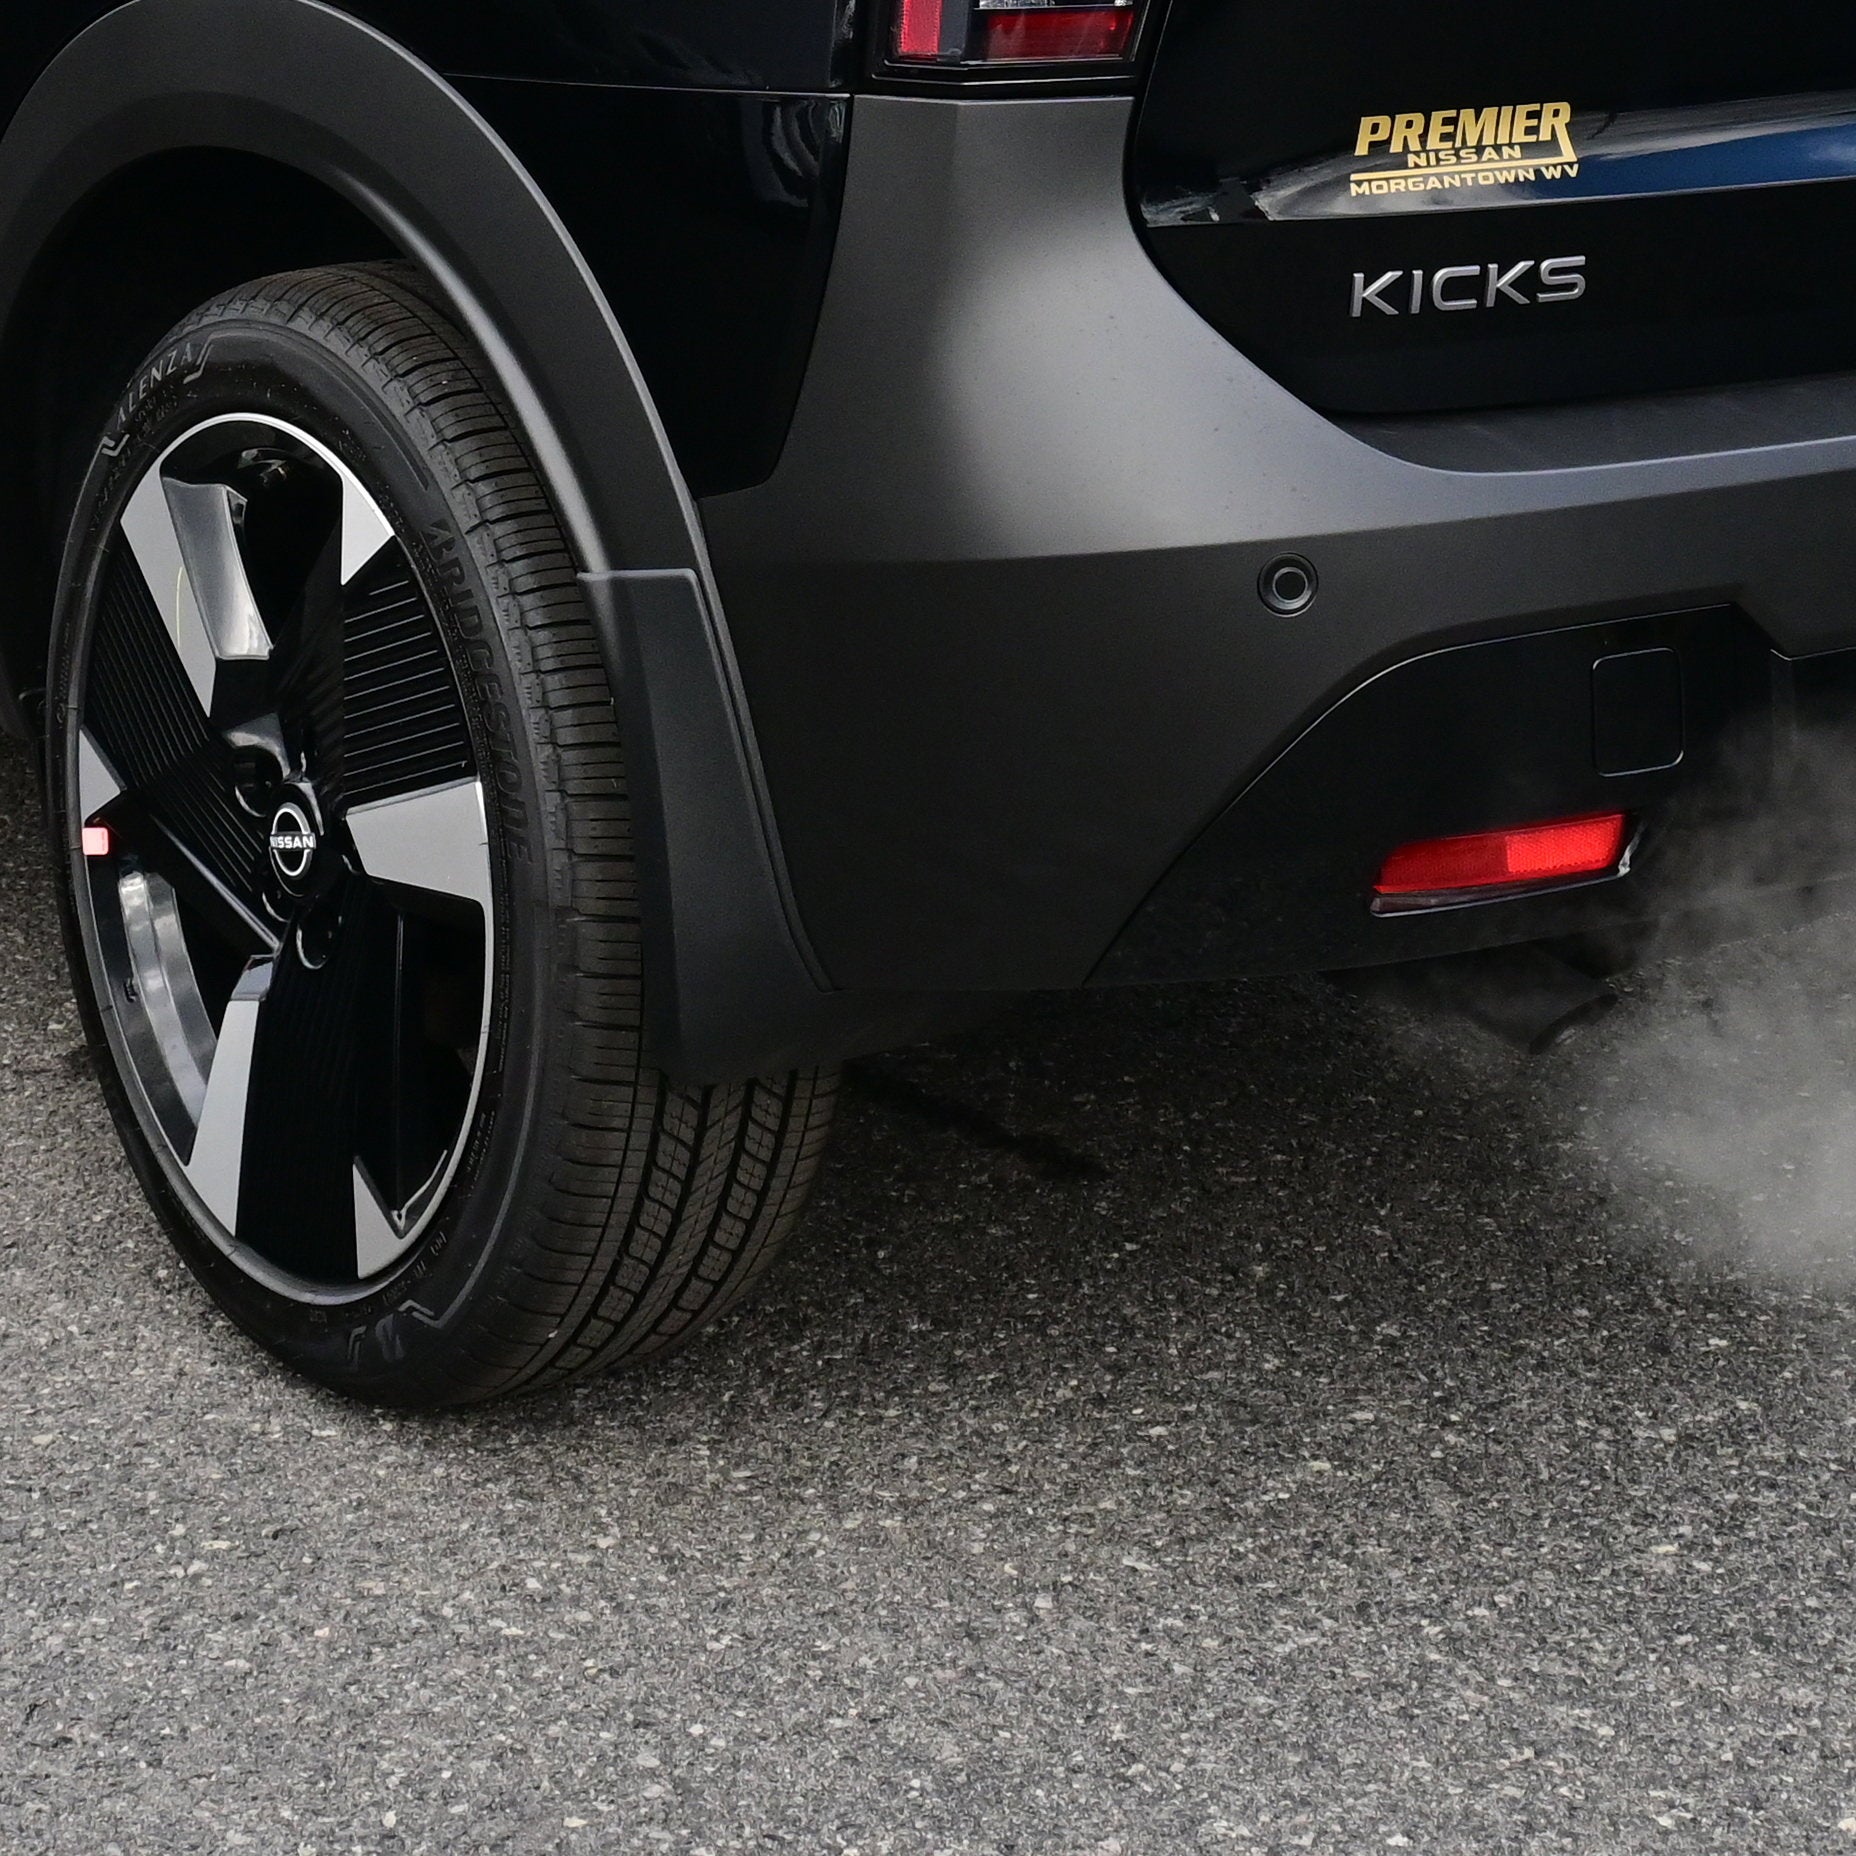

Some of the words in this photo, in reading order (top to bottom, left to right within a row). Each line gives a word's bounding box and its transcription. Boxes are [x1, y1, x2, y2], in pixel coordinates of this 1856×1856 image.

[1353, 101, 1574, 157] PREMIER
[1407, 145, 1522, 168] NISSAN
[1350, 169, 1535, 197] MORGANTOWN
[1540, 163, 1579, 179] WV
[1349, 255, 1586, 318] KICKS
[117, 342, 193, 432] ALENZA
[419, 517, 533, 864] BRIDGESTONE
